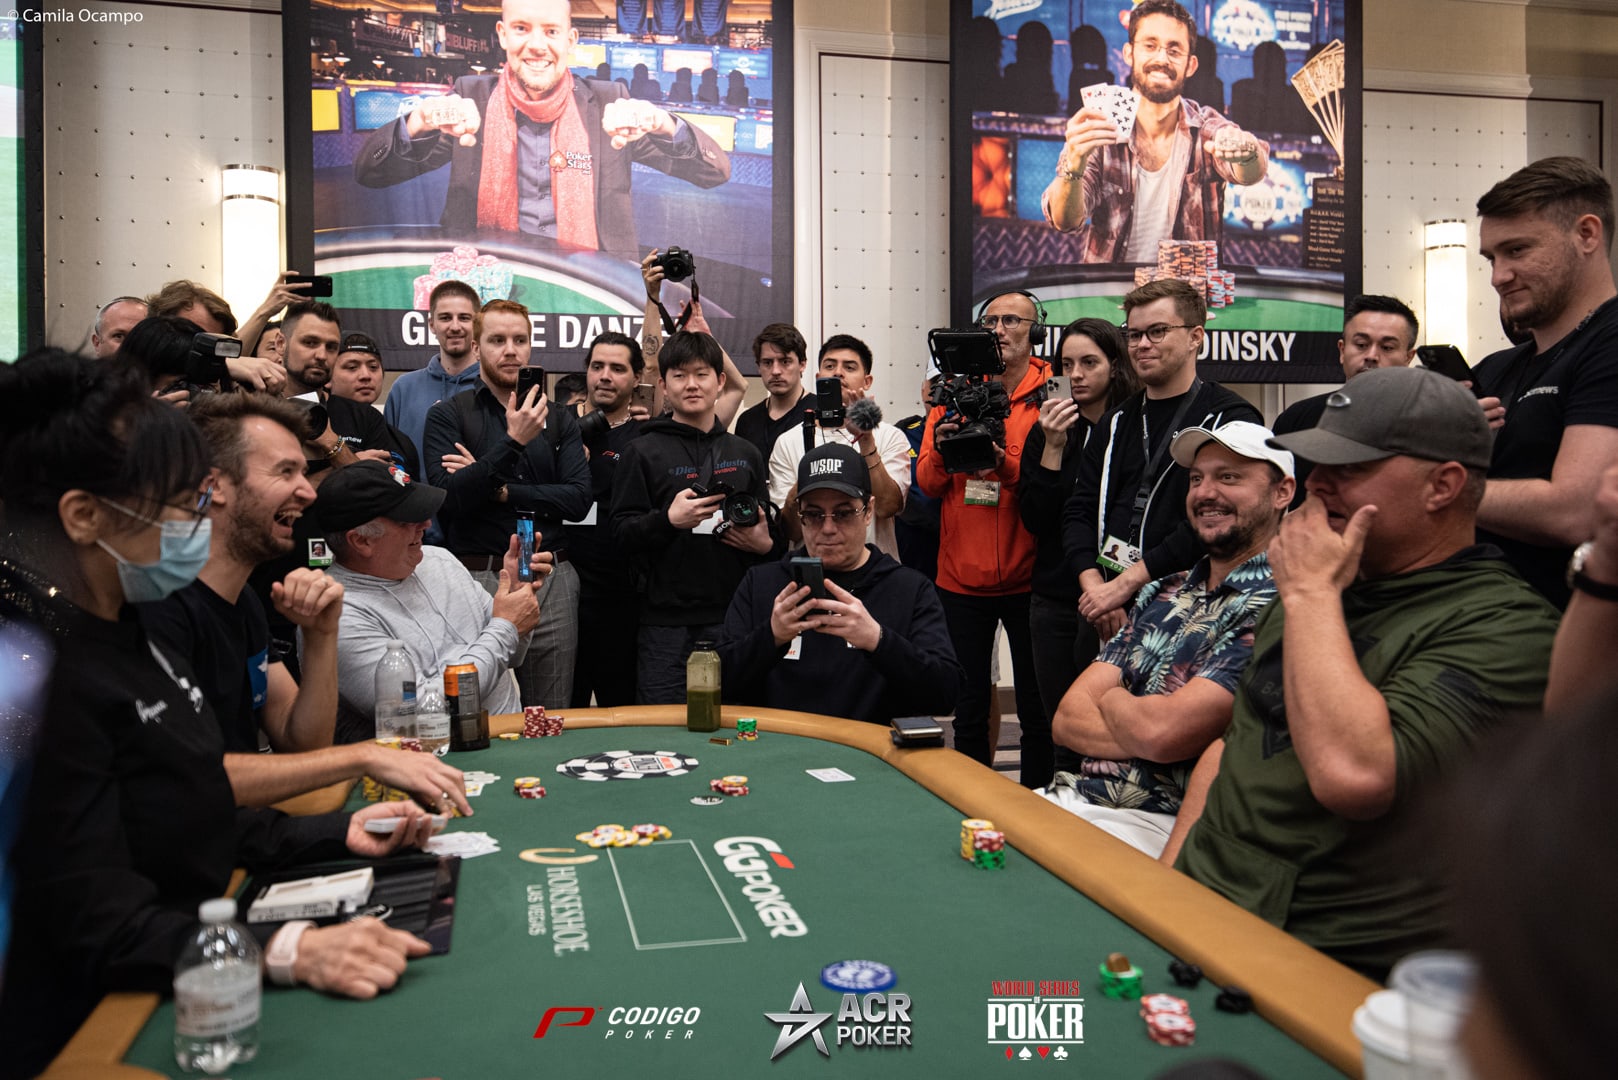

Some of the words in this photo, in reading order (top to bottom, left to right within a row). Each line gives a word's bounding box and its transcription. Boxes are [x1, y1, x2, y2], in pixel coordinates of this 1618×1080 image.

[566, 151, 592, 161] Poker
[567, 160, 592, 170] Stars
[809, 458, 842, 474] WSOP
[546, 866, 590, 957] HORSESHOE
